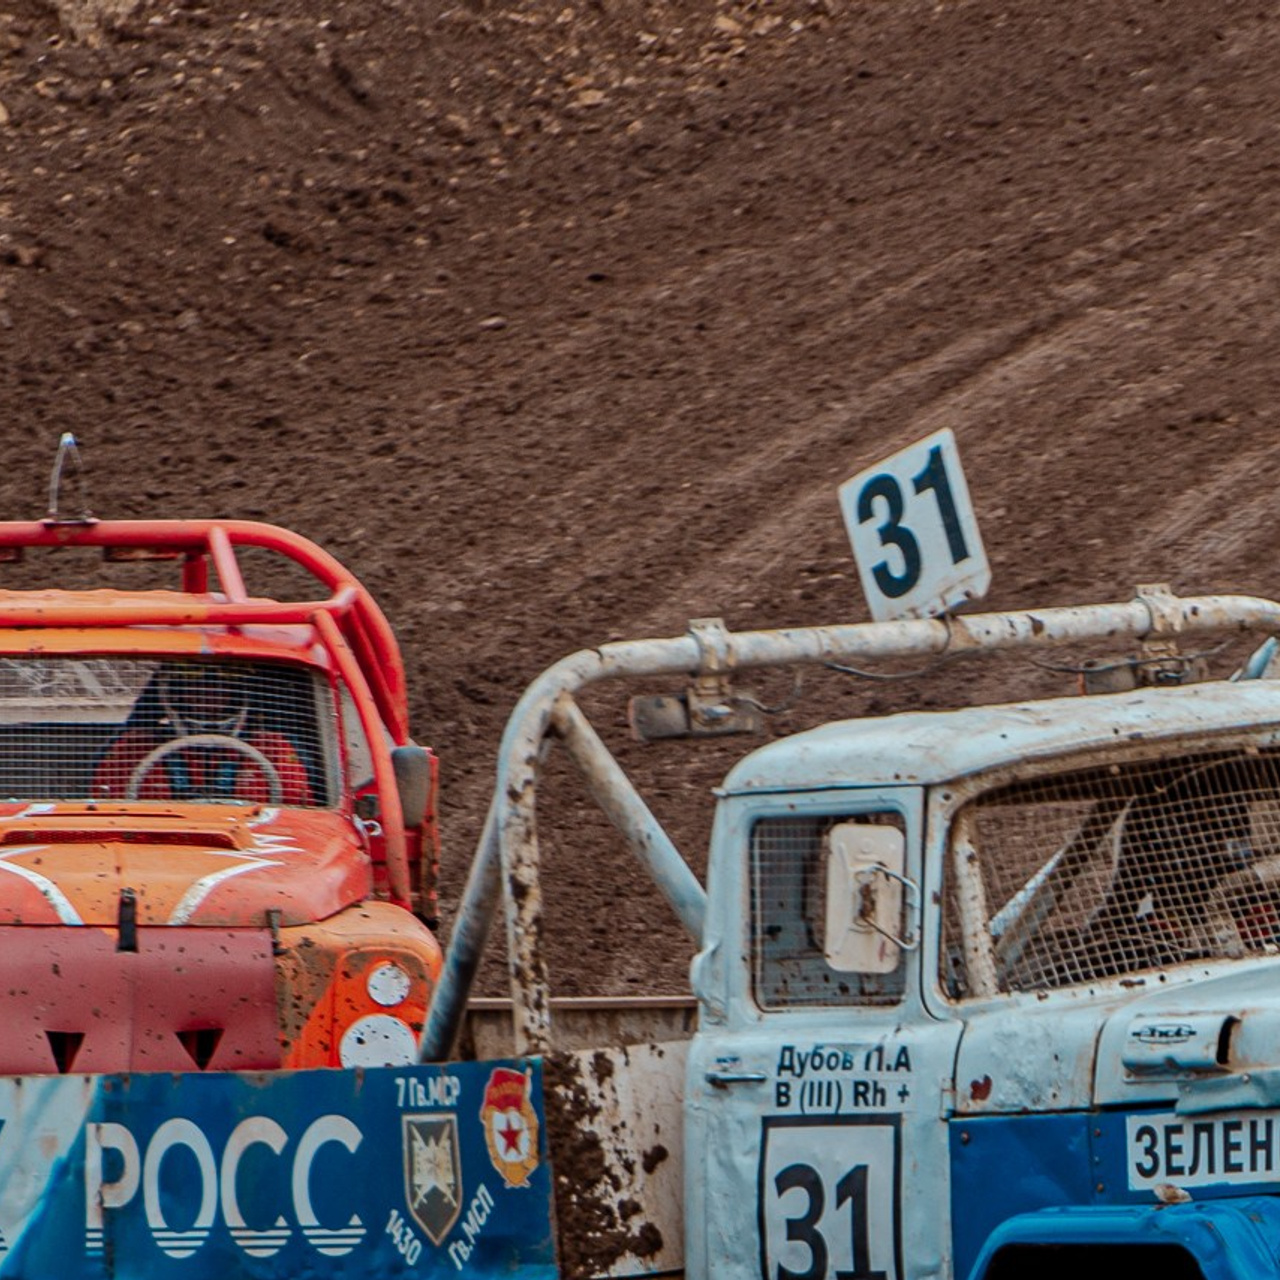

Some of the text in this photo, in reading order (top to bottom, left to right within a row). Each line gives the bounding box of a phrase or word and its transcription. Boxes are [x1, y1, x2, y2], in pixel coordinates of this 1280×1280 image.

[858, 445, 970, 599] 31
[777, 1044, 854, 1078] Дубов
[853, 1080, 886, 1107] Rh
[85, 1114, 368, 1258] РОСС
